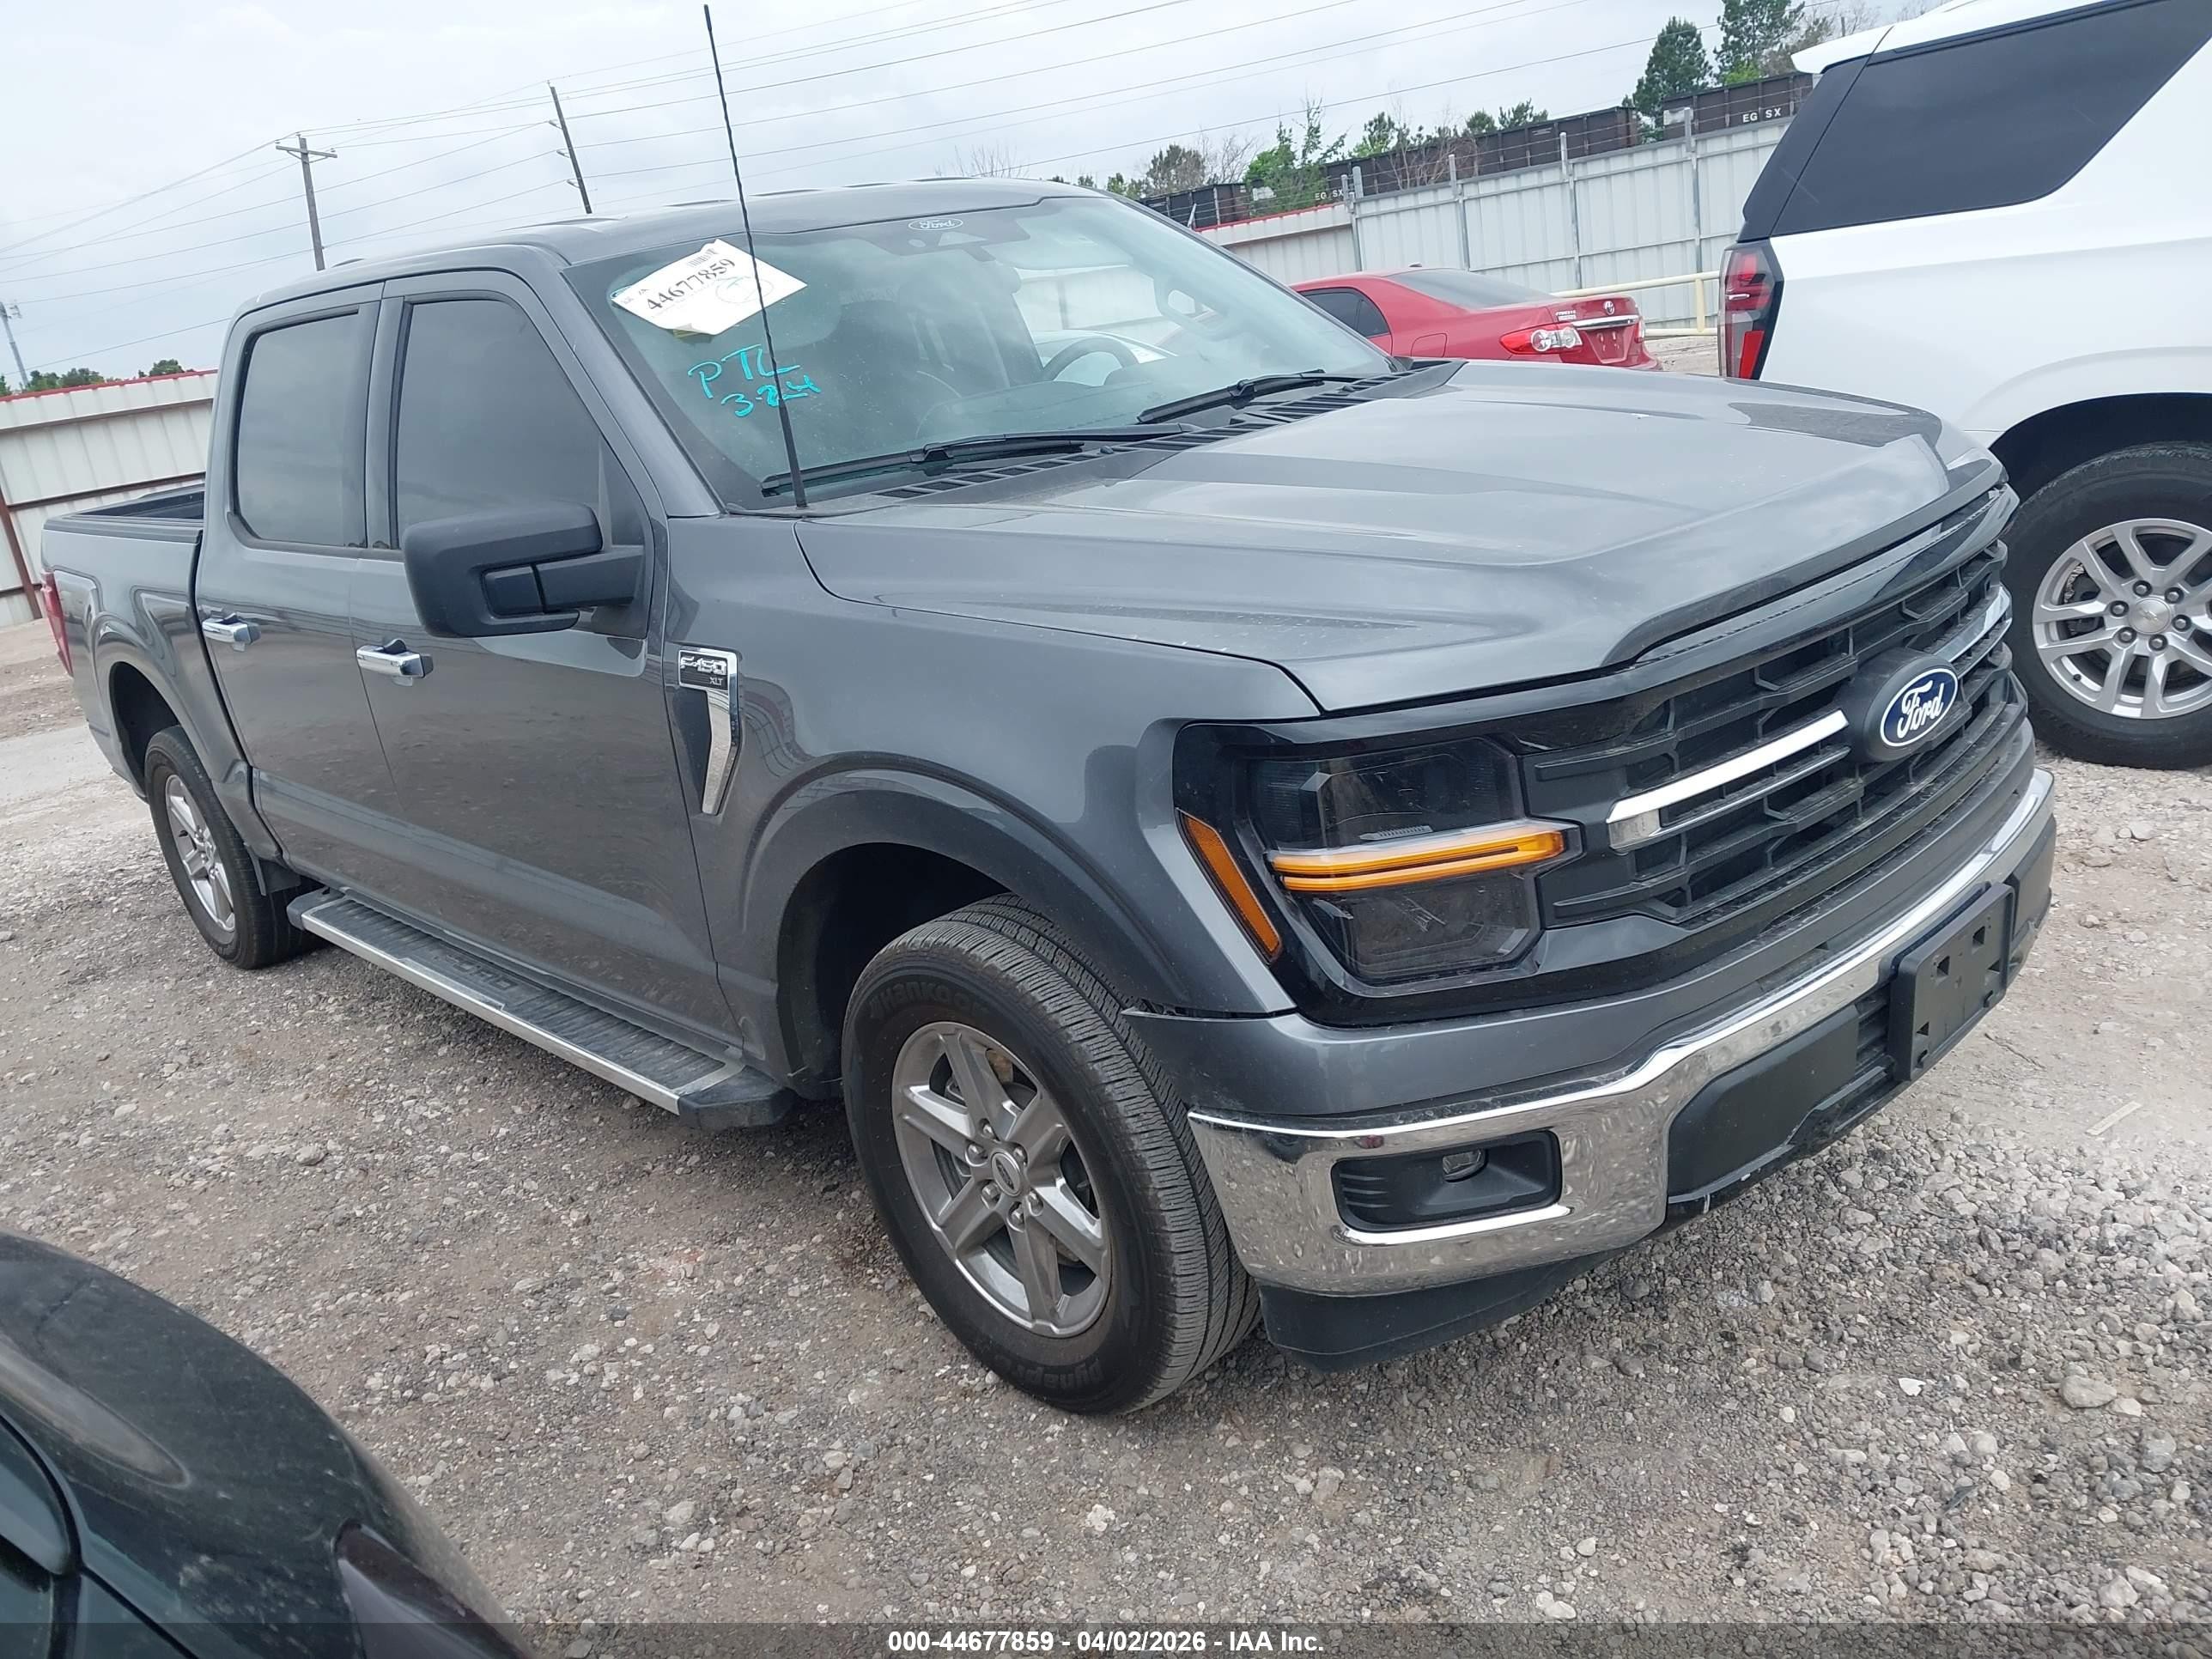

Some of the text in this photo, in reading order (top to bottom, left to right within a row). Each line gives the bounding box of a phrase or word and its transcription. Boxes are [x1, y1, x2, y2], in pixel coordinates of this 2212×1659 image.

[1741, 107, 1782, 124] EG SX
[647, 258, 736, 310] 44677859
[687, 343, 801, 399] PTL
[680, 655, 727, 676] F-150
[709, 676, 724, 686] XLT
[1896, 679, 1946, 739] Ford
